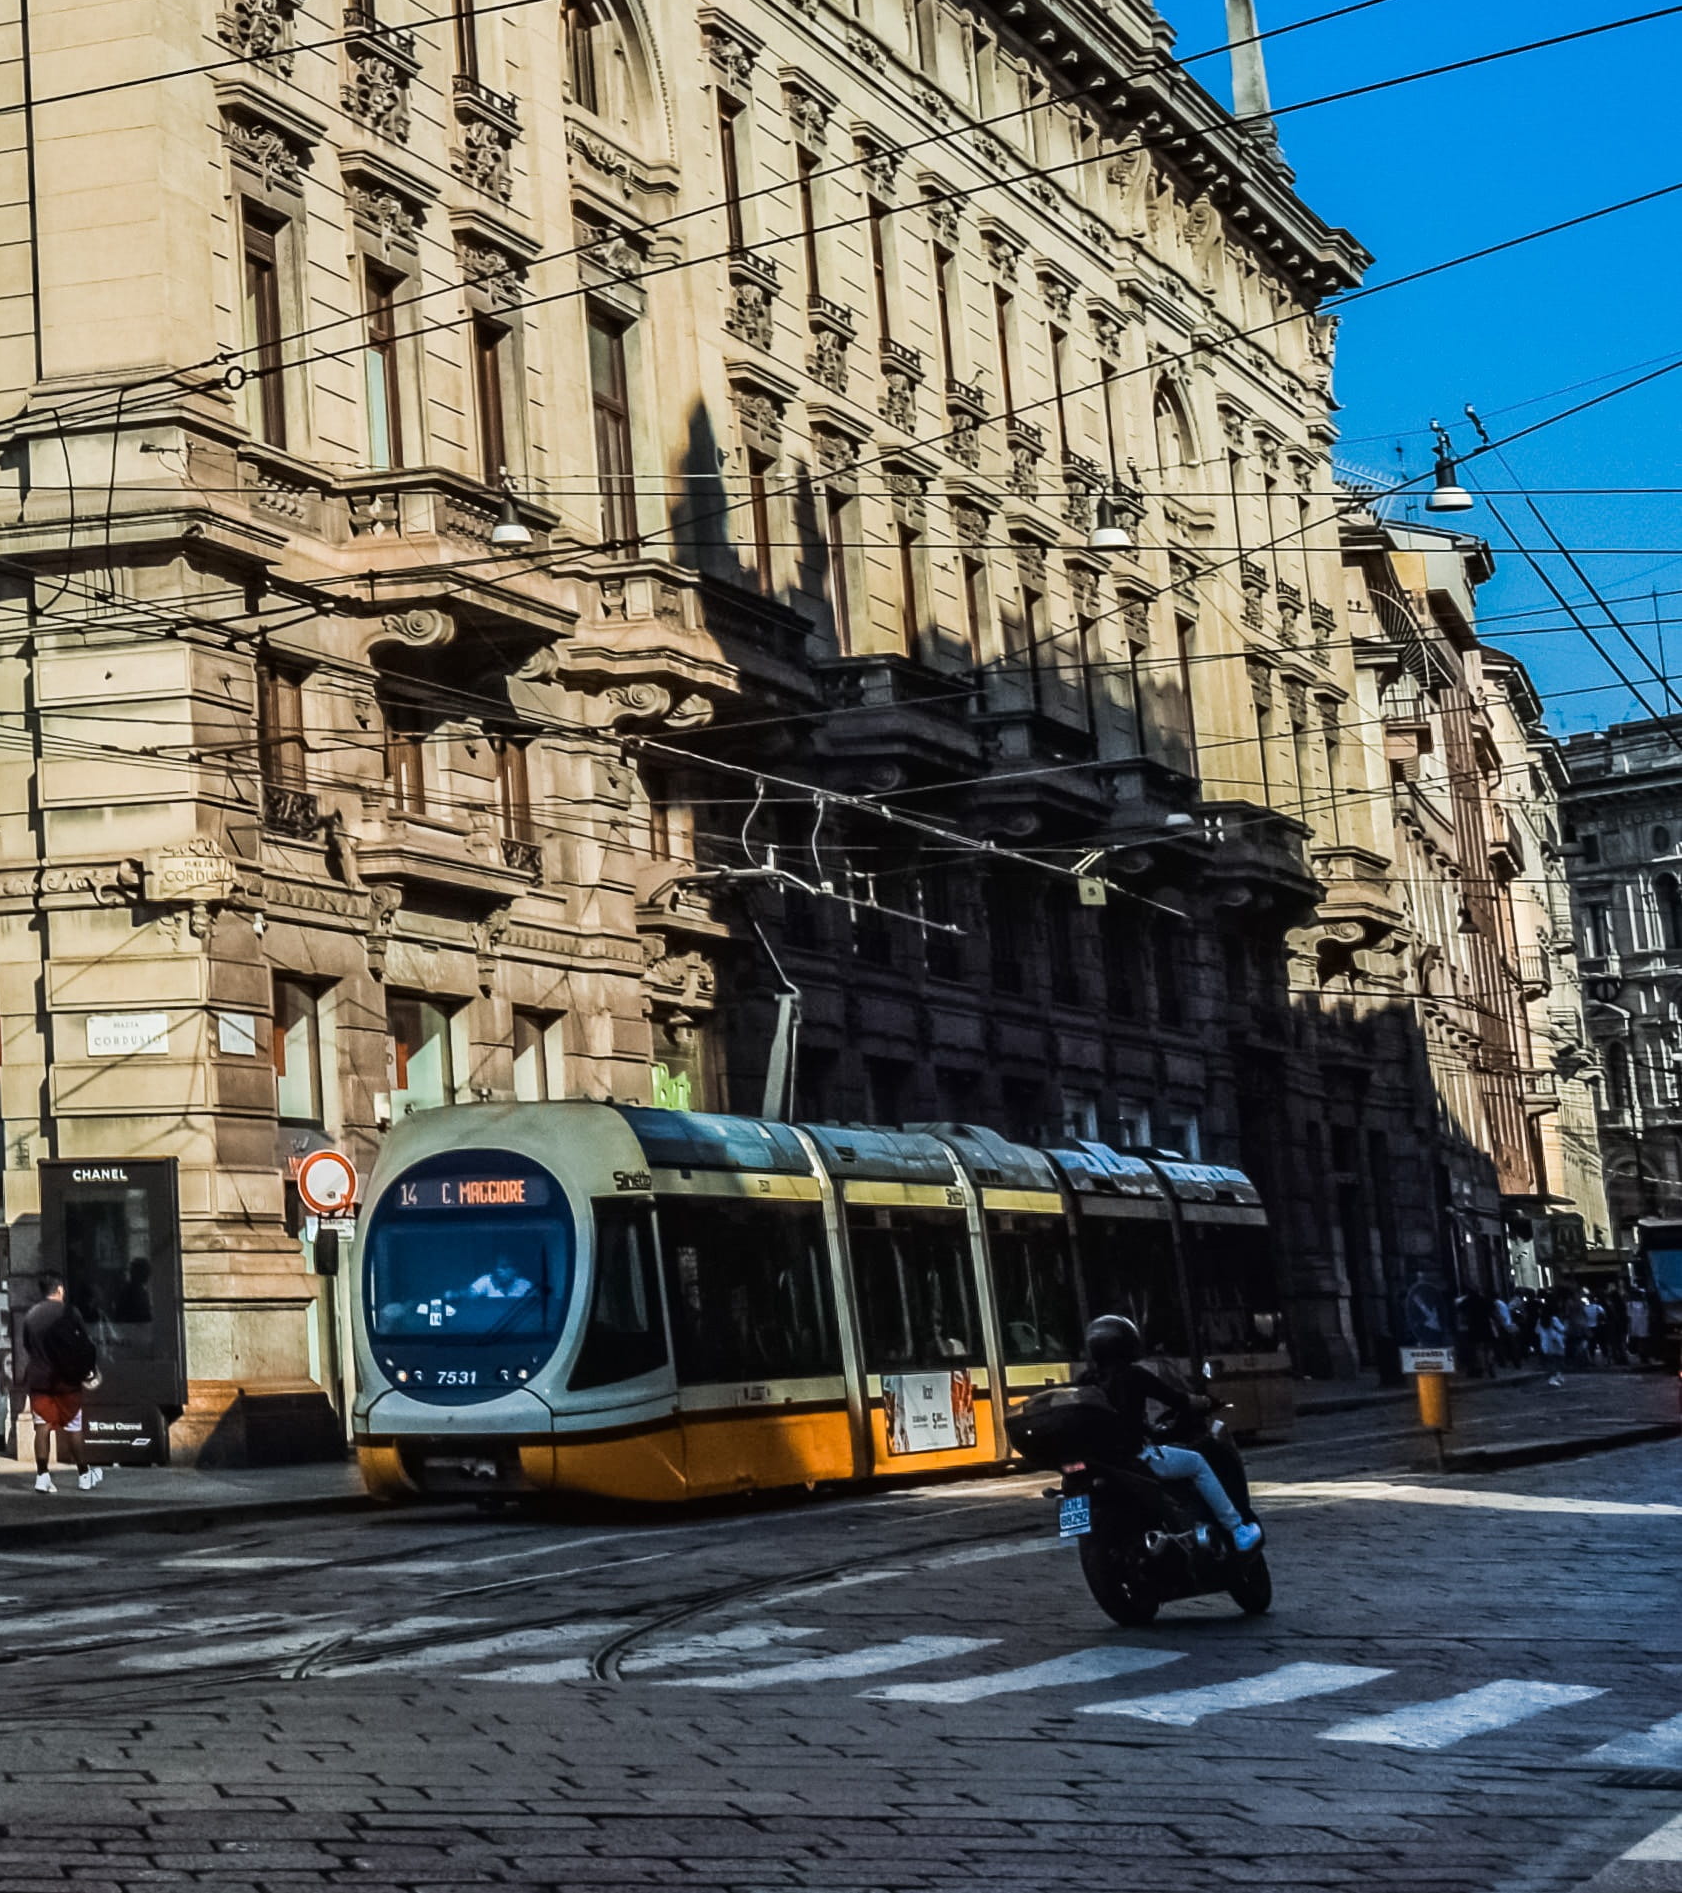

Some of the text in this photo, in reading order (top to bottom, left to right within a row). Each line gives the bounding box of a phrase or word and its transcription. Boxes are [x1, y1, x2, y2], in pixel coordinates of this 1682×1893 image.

[72, 1168, 128, 1182] CHANEL
[401, 1183, 418, 1205] 14
[459, 1180, 526, 1204] MAGGIORE
[437, 1370, 477, 1385] 7531
